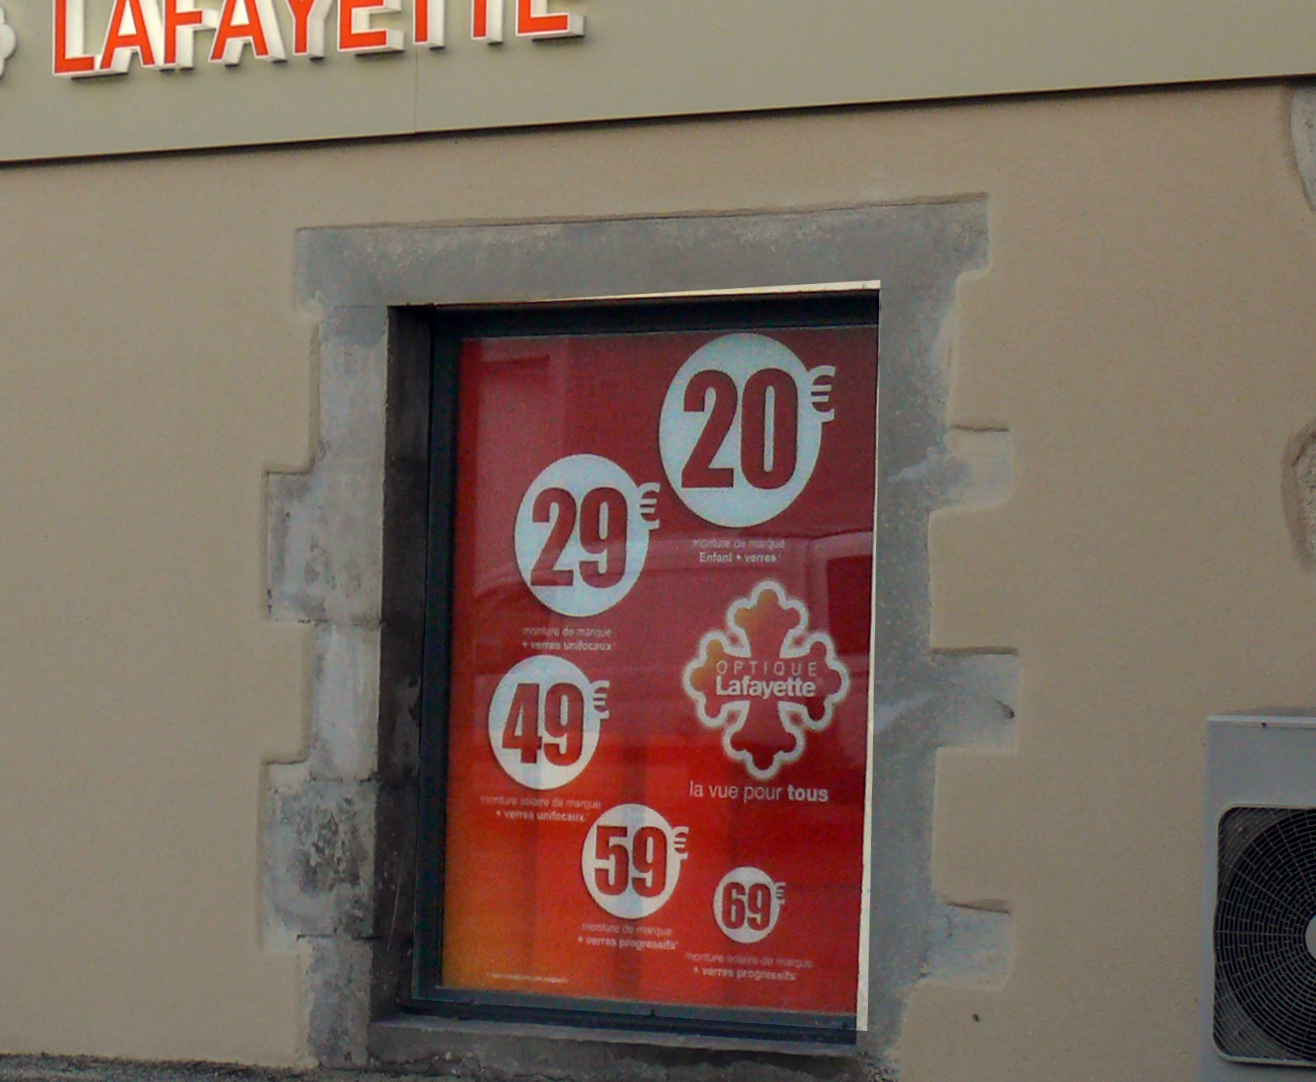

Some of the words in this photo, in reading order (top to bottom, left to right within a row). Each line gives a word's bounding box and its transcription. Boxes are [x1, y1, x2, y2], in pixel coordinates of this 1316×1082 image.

[716, 660, 817, 677] OPTIQUE
[716, 675, 817, 700] Lafayette
[689, 780, 703, 798] la
[709, 784, 739, 800] vue
[743, 785, 782, 804] pour
[787, 784, 830, 803] tous
